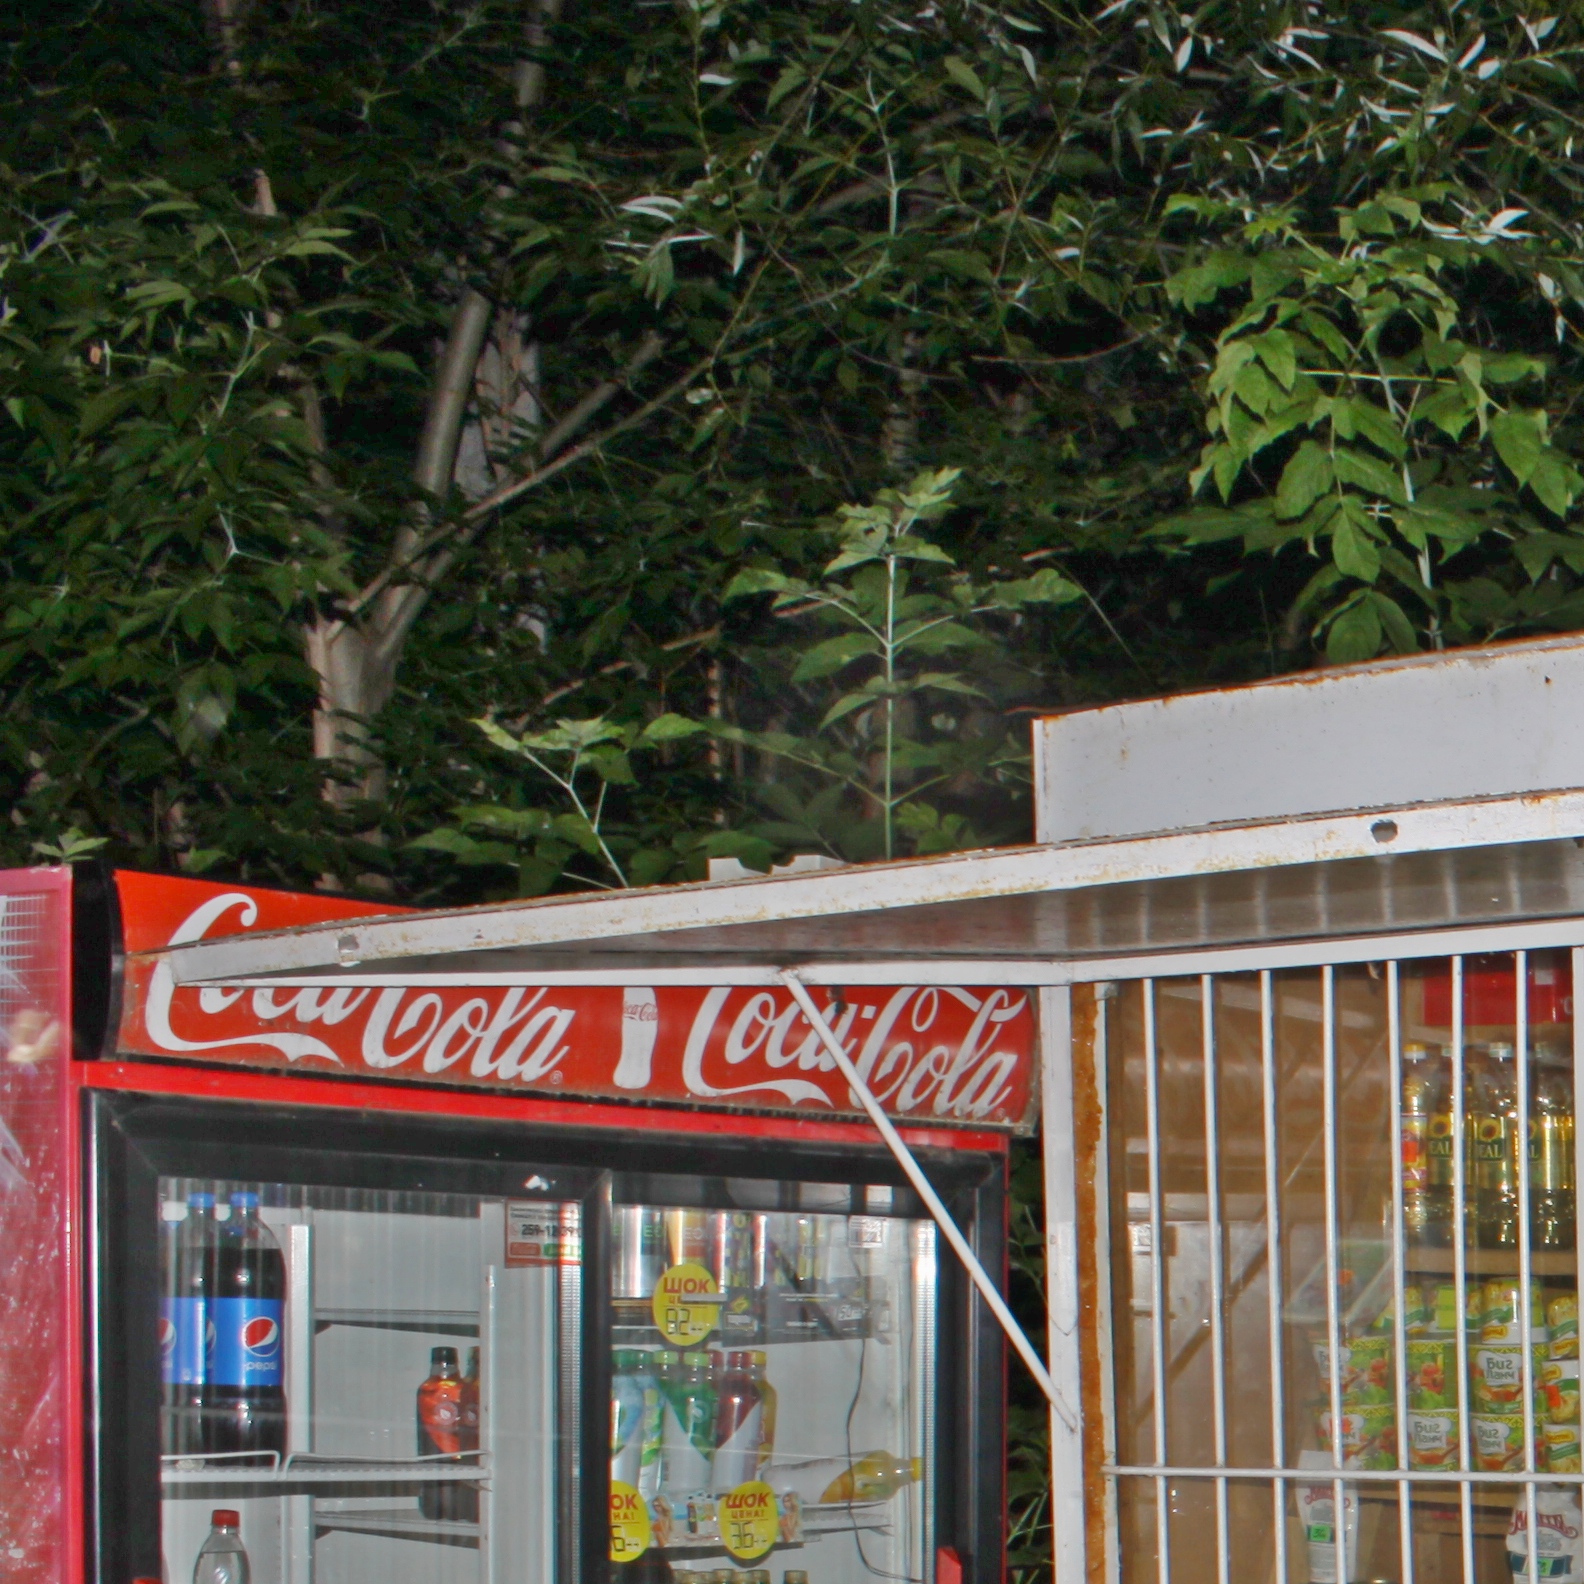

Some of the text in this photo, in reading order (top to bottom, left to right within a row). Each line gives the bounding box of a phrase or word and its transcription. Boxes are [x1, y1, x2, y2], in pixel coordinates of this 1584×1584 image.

[145, 893, 575, 1082] CaCola
[663, 1277, 710, 1295] ШОК
[610, 1493, 638, 1511] ОК
[725, 1491, 769, 1508] ШОК
[611, 1511, 636, 1522] НА!
